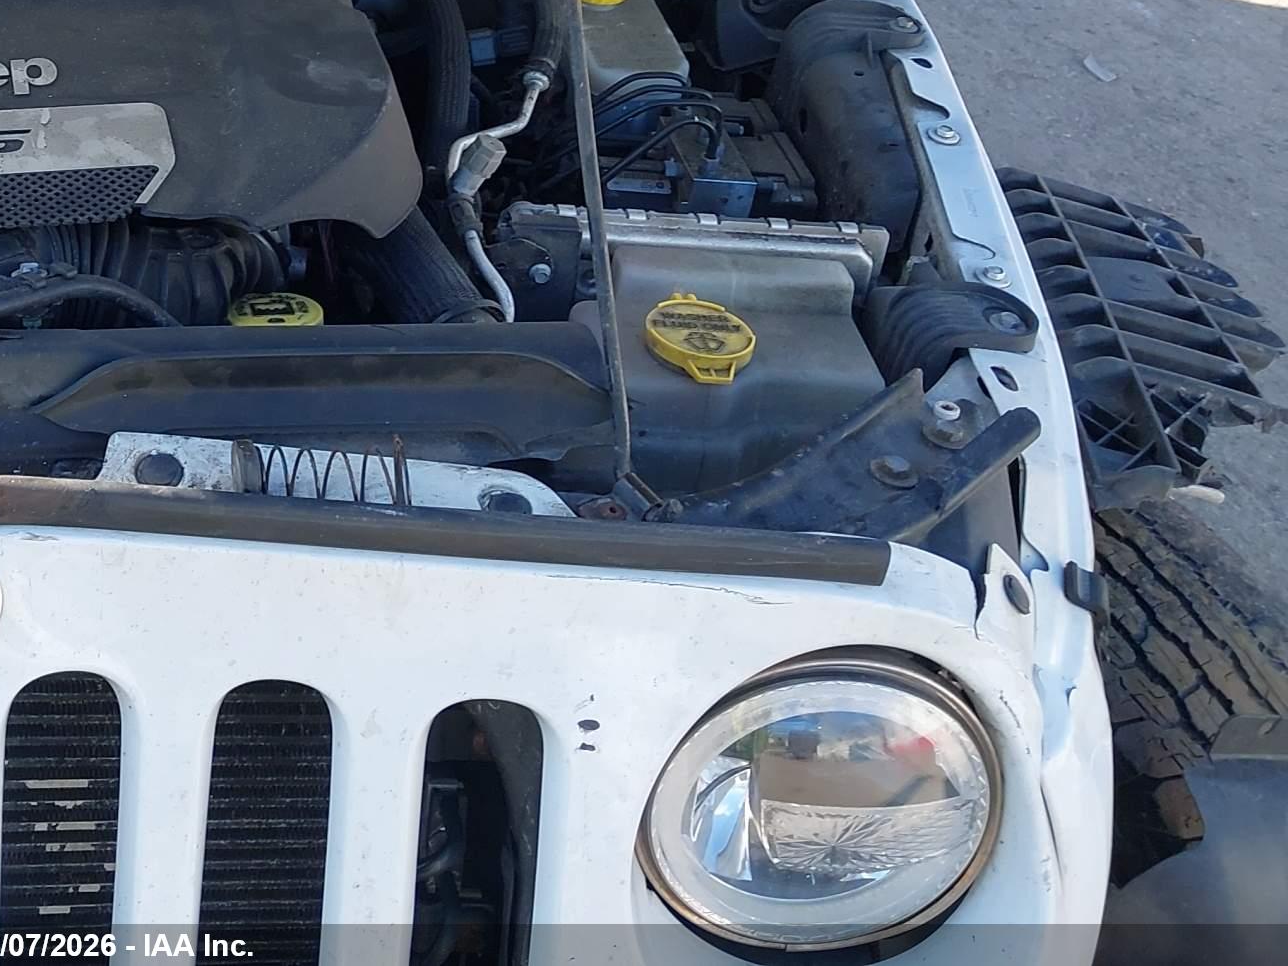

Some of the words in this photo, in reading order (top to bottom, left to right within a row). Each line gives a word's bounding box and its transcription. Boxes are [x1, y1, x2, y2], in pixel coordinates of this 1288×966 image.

[660, 312, 731, 322] WASHER
[651, 319, 698, 329] FLUID
[701, 322, 741, 332] ONLY
